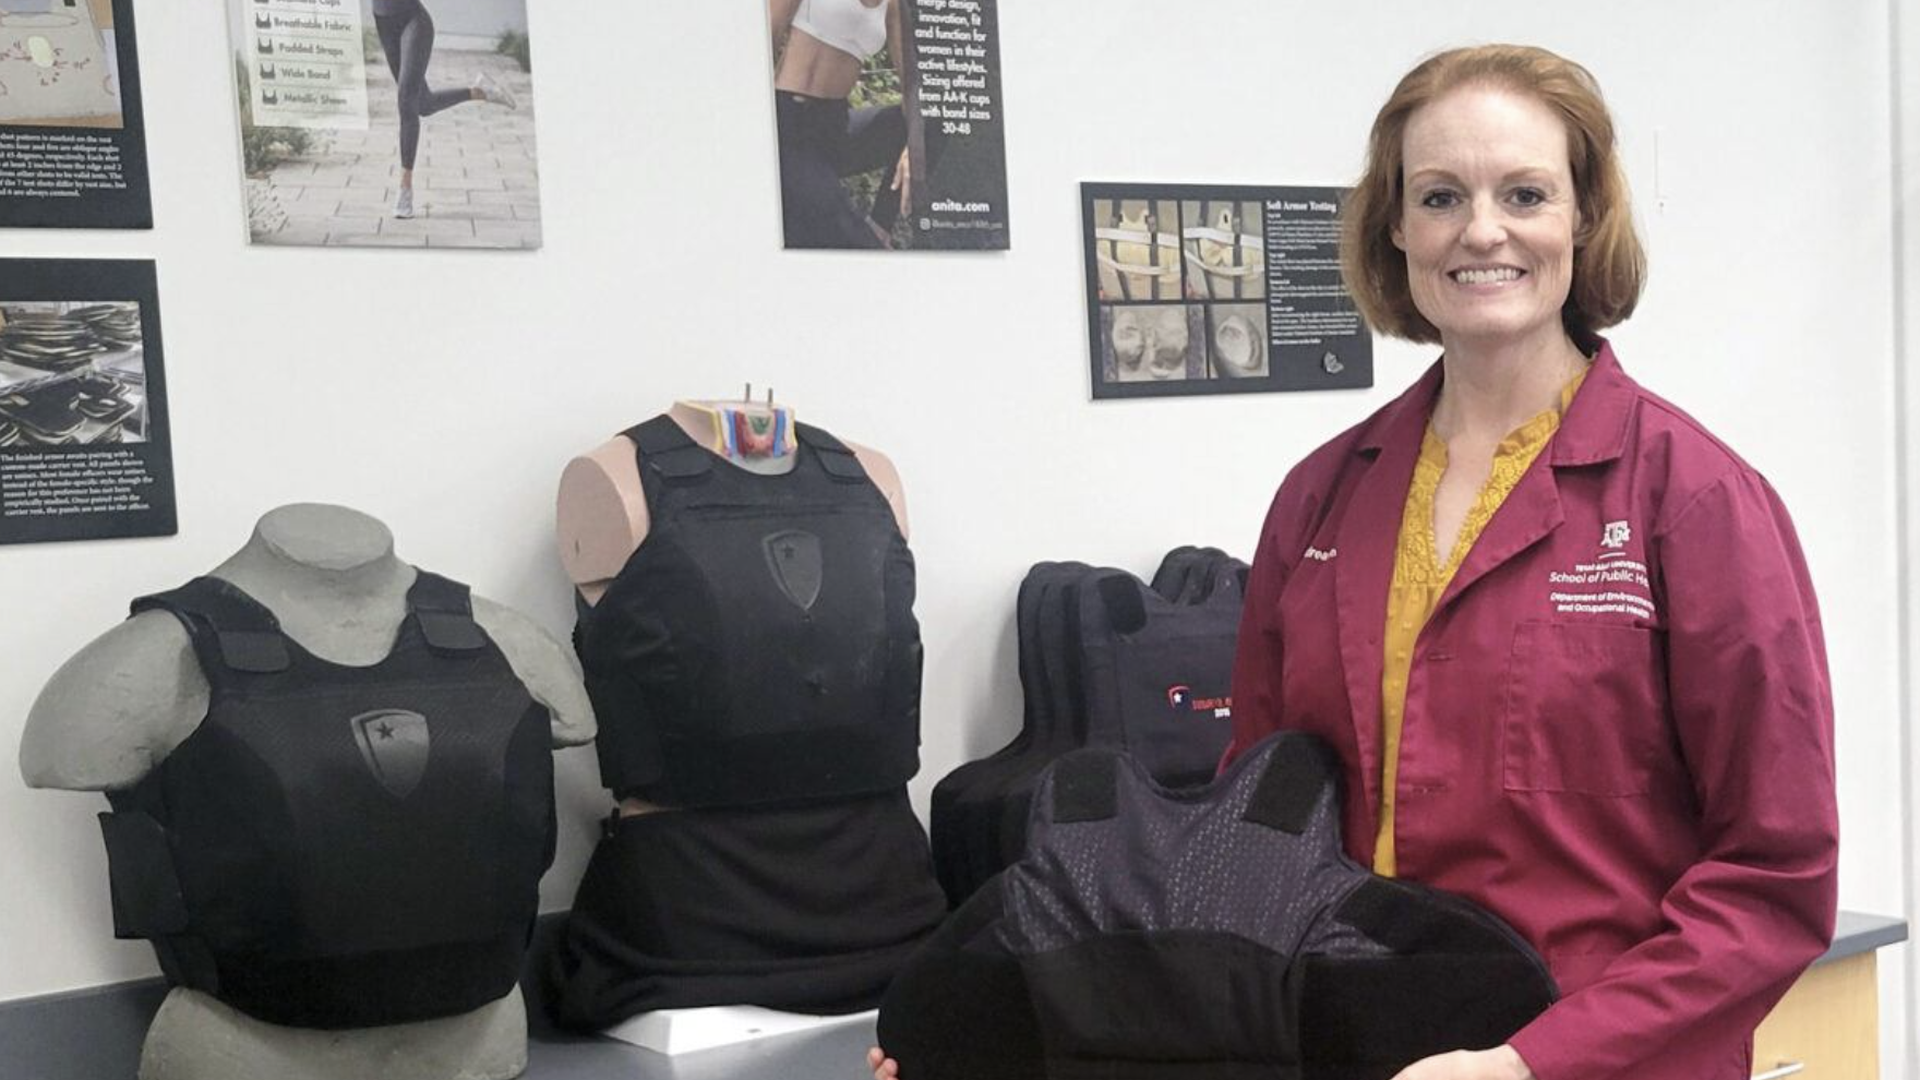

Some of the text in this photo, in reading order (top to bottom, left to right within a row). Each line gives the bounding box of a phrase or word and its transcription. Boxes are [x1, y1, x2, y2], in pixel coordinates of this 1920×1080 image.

[274, 17, 352, 31] Breathable Fabric
[919, 9, 981, 27] innovation, fit
[914, 26, 987, 42] and function for
[279, 42, 344, 57] Padded Straps
[917, 44, 987, 58] women in their
[917, 58, 945, 71] active
[281, 68, 331, 80] Wide Band
[922, 73, 985, 90] Sizing offered
[283, 93, 348, 105] Metallic Sheen
[918, 88, 990, 108] from AA-K cups
[920, 104, 991, 120] with band sizes
[942, 121, 972, 135] 30-48
[931, 198, 990, 212] anita.com
[1284, 201, 1309, 212] Armor
[1309, 200, 1338, 214] Testing
[1549, 571, 1586, 584] School
[1587, 571, 1600, 584] of
[1601, 569, 1634, 583] Public
[1557, 604, 1574, 612] and
[1574, 604, 1626, 614] Occupational
